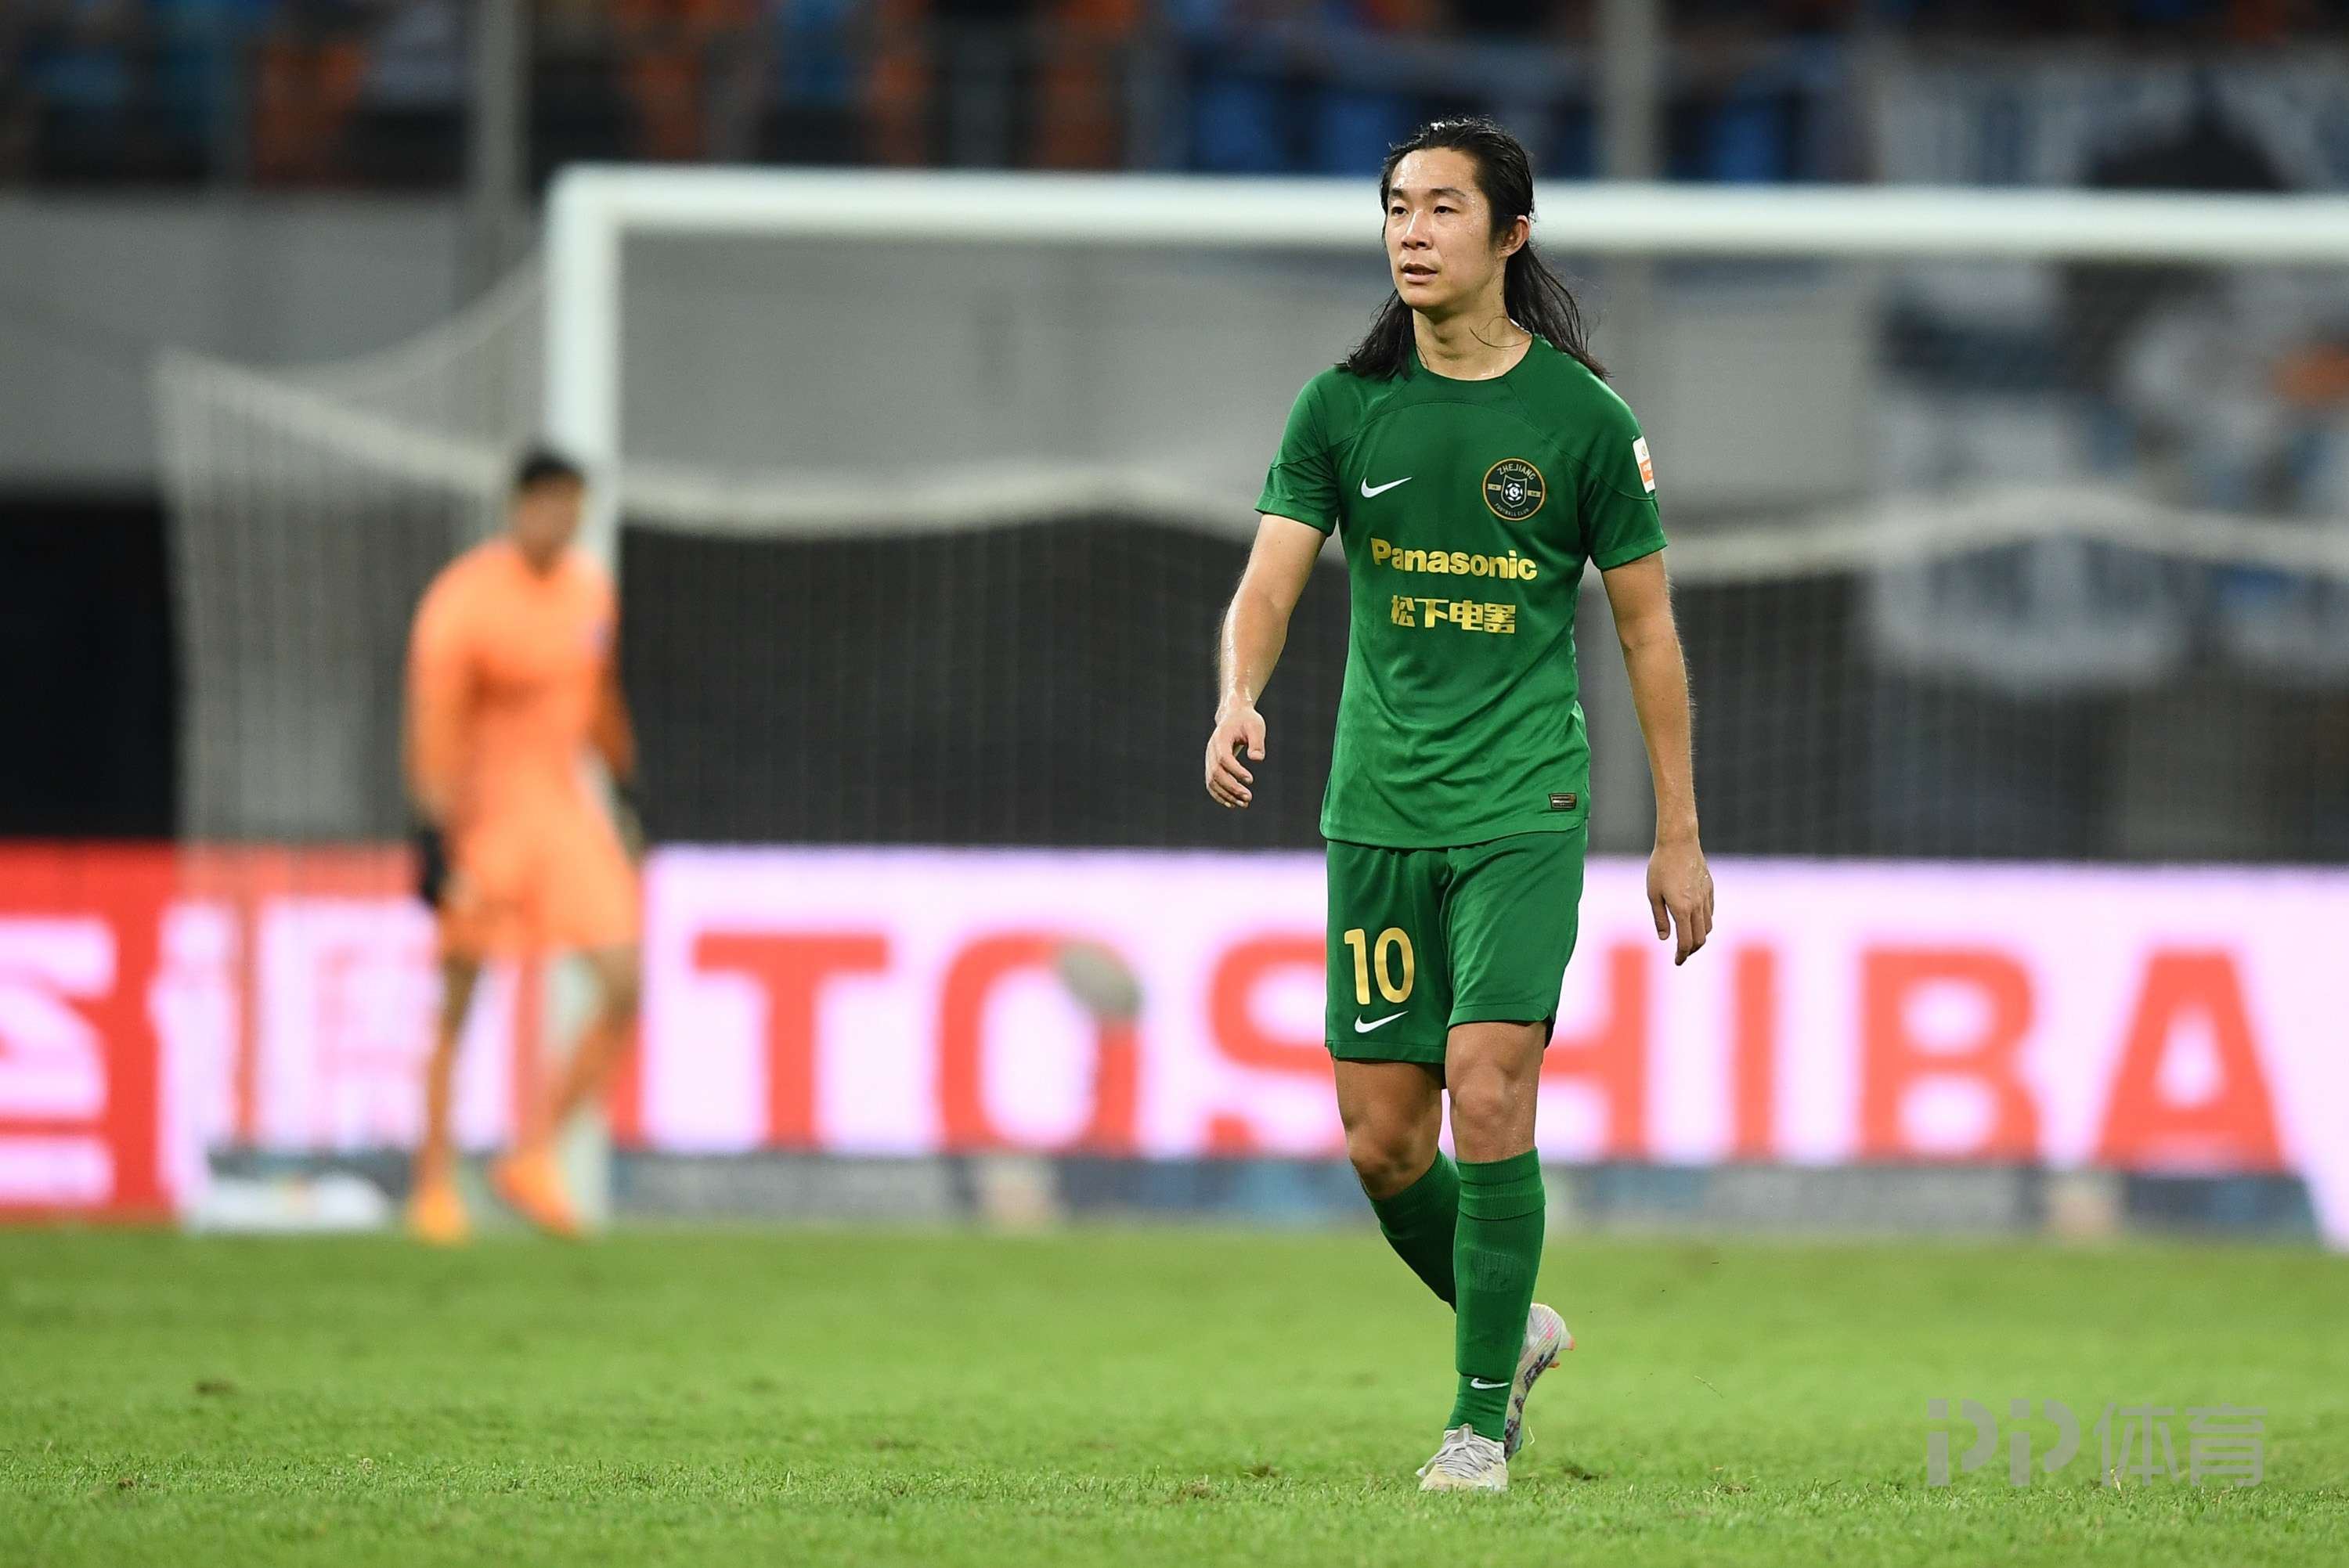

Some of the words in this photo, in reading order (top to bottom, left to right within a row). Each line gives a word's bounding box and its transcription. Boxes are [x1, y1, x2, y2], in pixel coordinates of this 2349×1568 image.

[1496, 463, 1536, 481] ZHEJIANG
[1371, 537, 1538, 580] Panasonic
[1391, 594, 1516, 634] 松下电器
[1344, 927, 1415, 1005] 10
